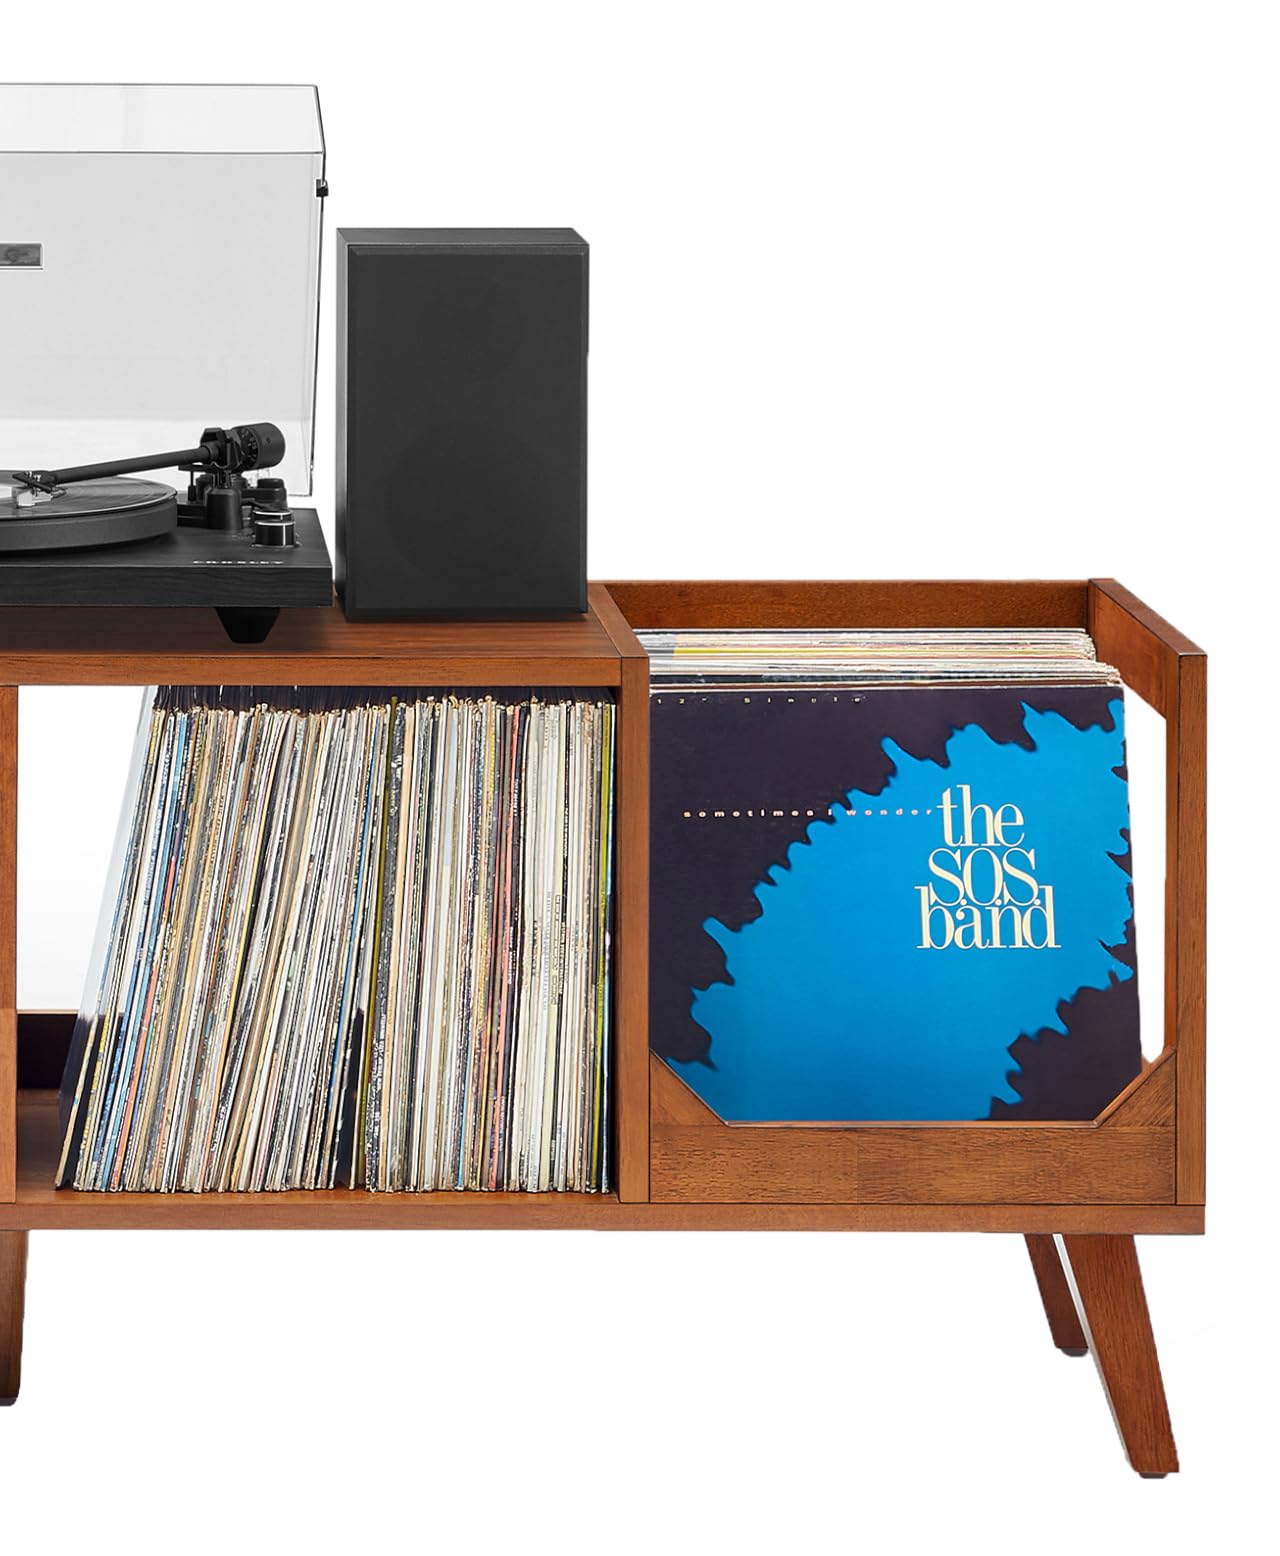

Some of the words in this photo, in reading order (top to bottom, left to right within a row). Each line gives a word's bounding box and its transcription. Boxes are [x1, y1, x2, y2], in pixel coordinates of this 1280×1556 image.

[683, 809, 814, 818] sometimes
[845, 807, 933, 817] wonder
[936, 784, 1025, 848] the
[914, 885, 1062, 950] band
